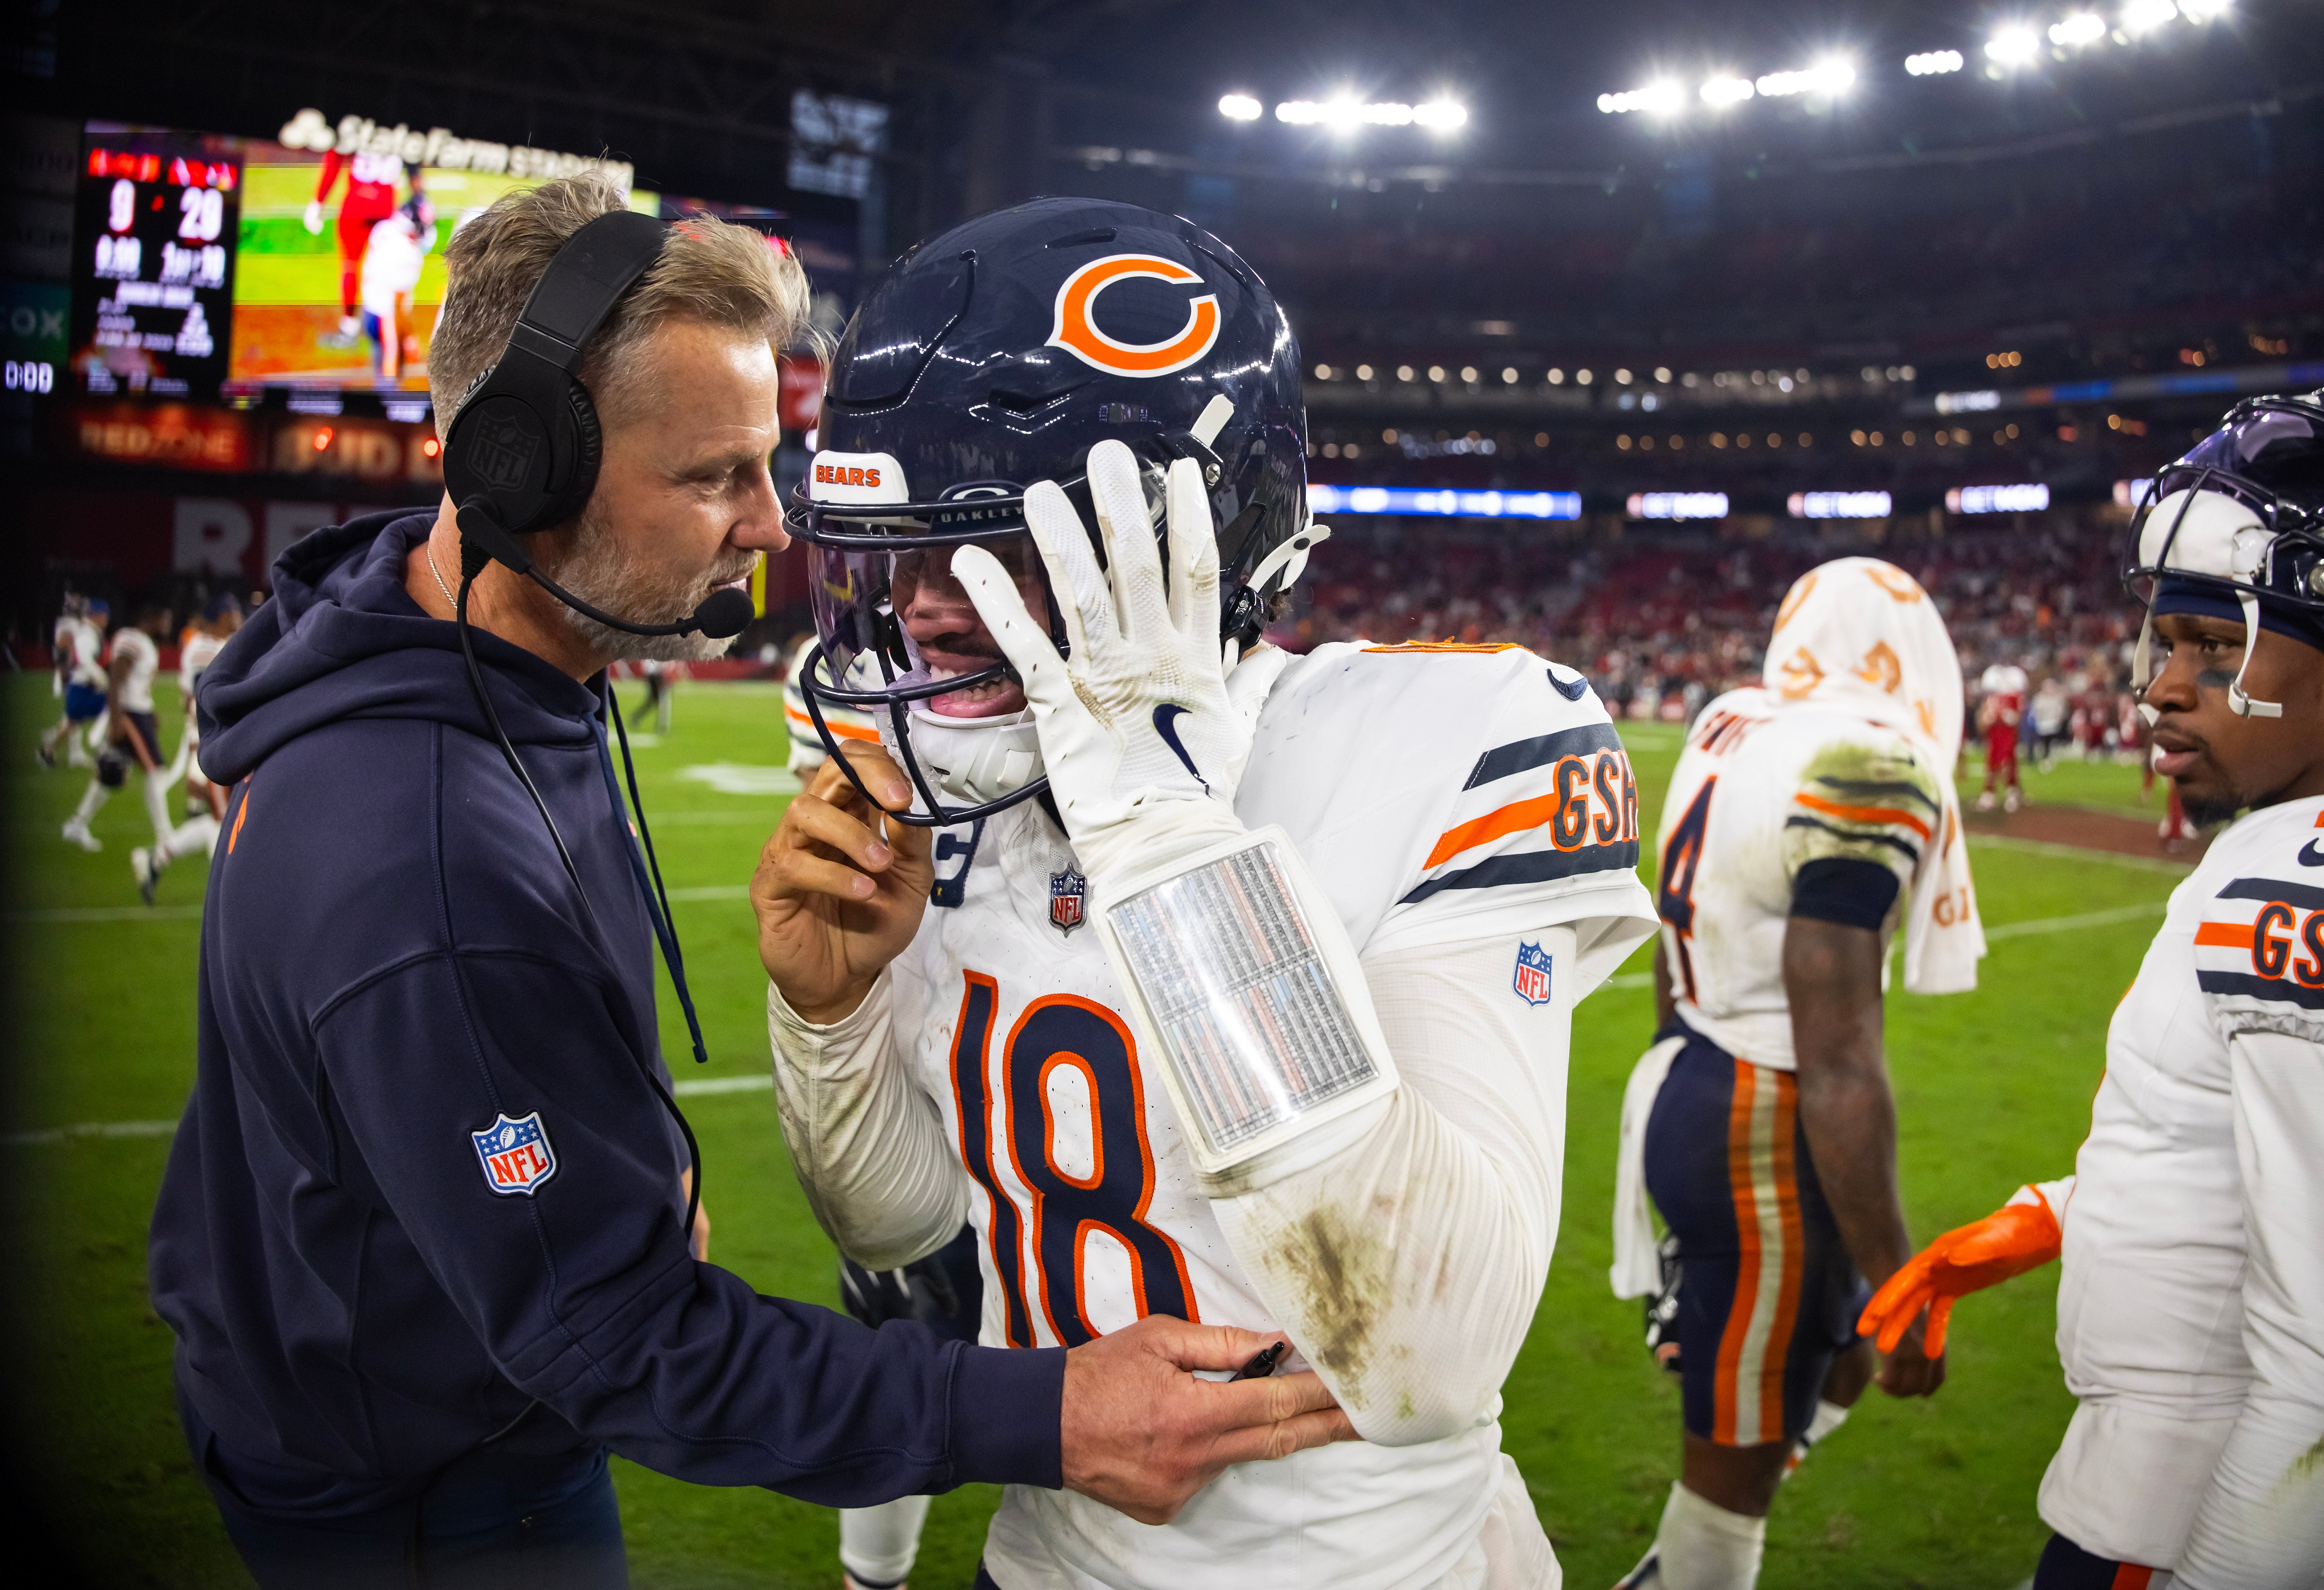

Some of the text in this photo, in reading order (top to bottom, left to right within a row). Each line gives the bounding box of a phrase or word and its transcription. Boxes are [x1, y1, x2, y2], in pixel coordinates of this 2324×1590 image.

[0, 306, 64, 340] OX
[473, 440, 520, 483] NFL
[816, 464, 881, 488] BEARS
[940, 506, 1024, 523] OAKLEY
[1550, 747, 1639, 852] GSH
[1053, 897, 1081, 924] NFL
[1517, 965, 1548, 1000] NFL
[489, 1144, 547, 1183] NFL
[949, 969, 1200, 1349] 18
